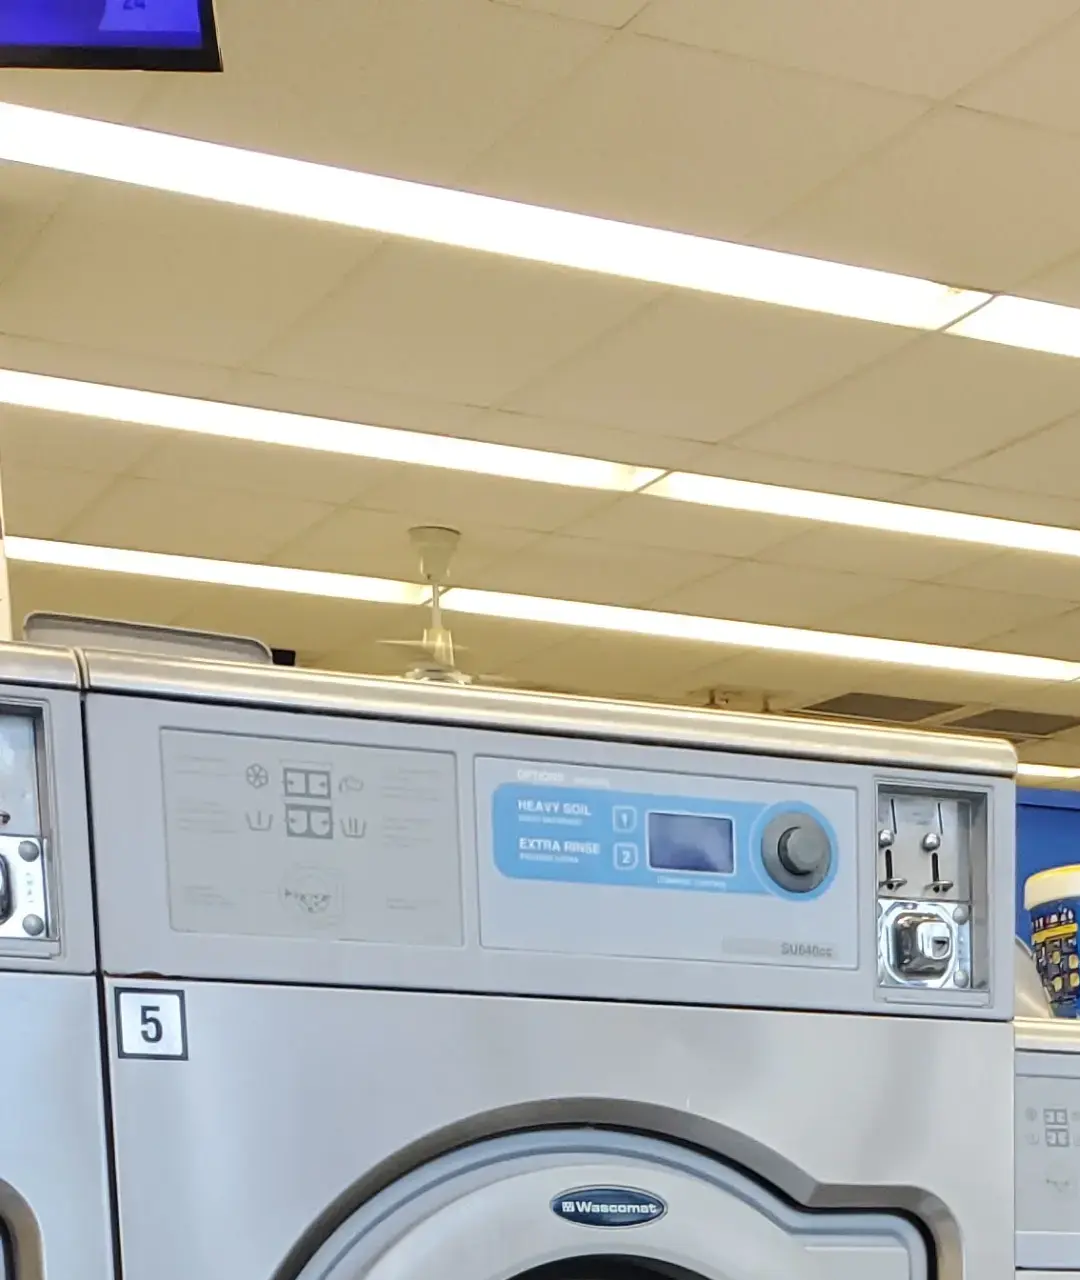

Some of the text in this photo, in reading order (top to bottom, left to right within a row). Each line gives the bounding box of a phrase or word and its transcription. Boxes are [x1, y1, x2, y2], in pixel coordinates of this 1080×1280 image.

[517, 799, 592, 816] HEAVY SOIL
[519, 837, 600, 855] EXTRA RINSE
[621, 850, 631, 864] 2
[139, 1005, 164, 1044] 5
[576, 1201, 657, 1214] Wascomat
